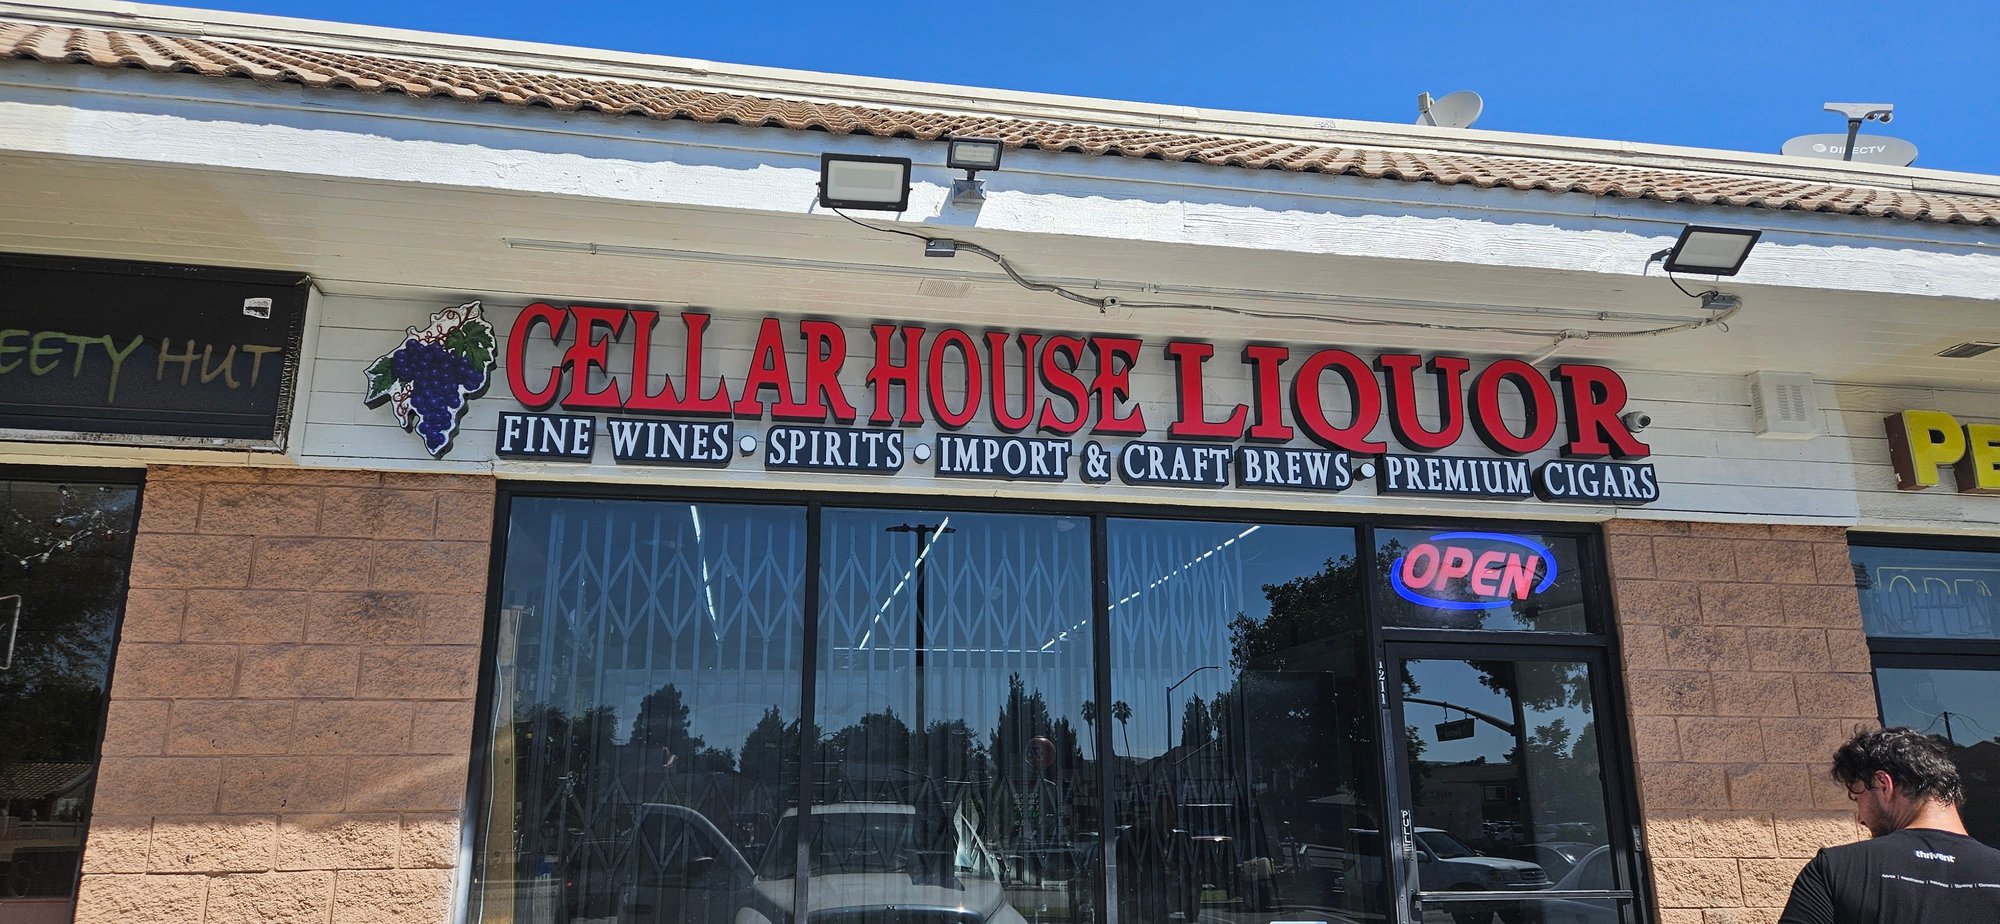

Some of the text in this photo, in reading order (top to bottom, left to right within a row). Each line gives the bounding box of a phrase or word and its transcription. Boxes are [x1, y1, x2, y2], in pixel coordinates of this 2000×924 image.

[1829, 145, 1886, 155] DIECTV
[156, 336, 283, 390] HUT
[507, 303, 1650, 457] CELLAR HOUSE LIQUOR
[500, 415, 1656, 499] FINE WINES SPIRITS IMPORT & CRAFT BREWS PREMIUM CIGARS
[1402, 543, 1539, 600] OPEN
[1378, 660, 1386, 704] 1211
[1401, 810, 1412, 845] PULL
[1915, 850, 1956, 863] thrivent
